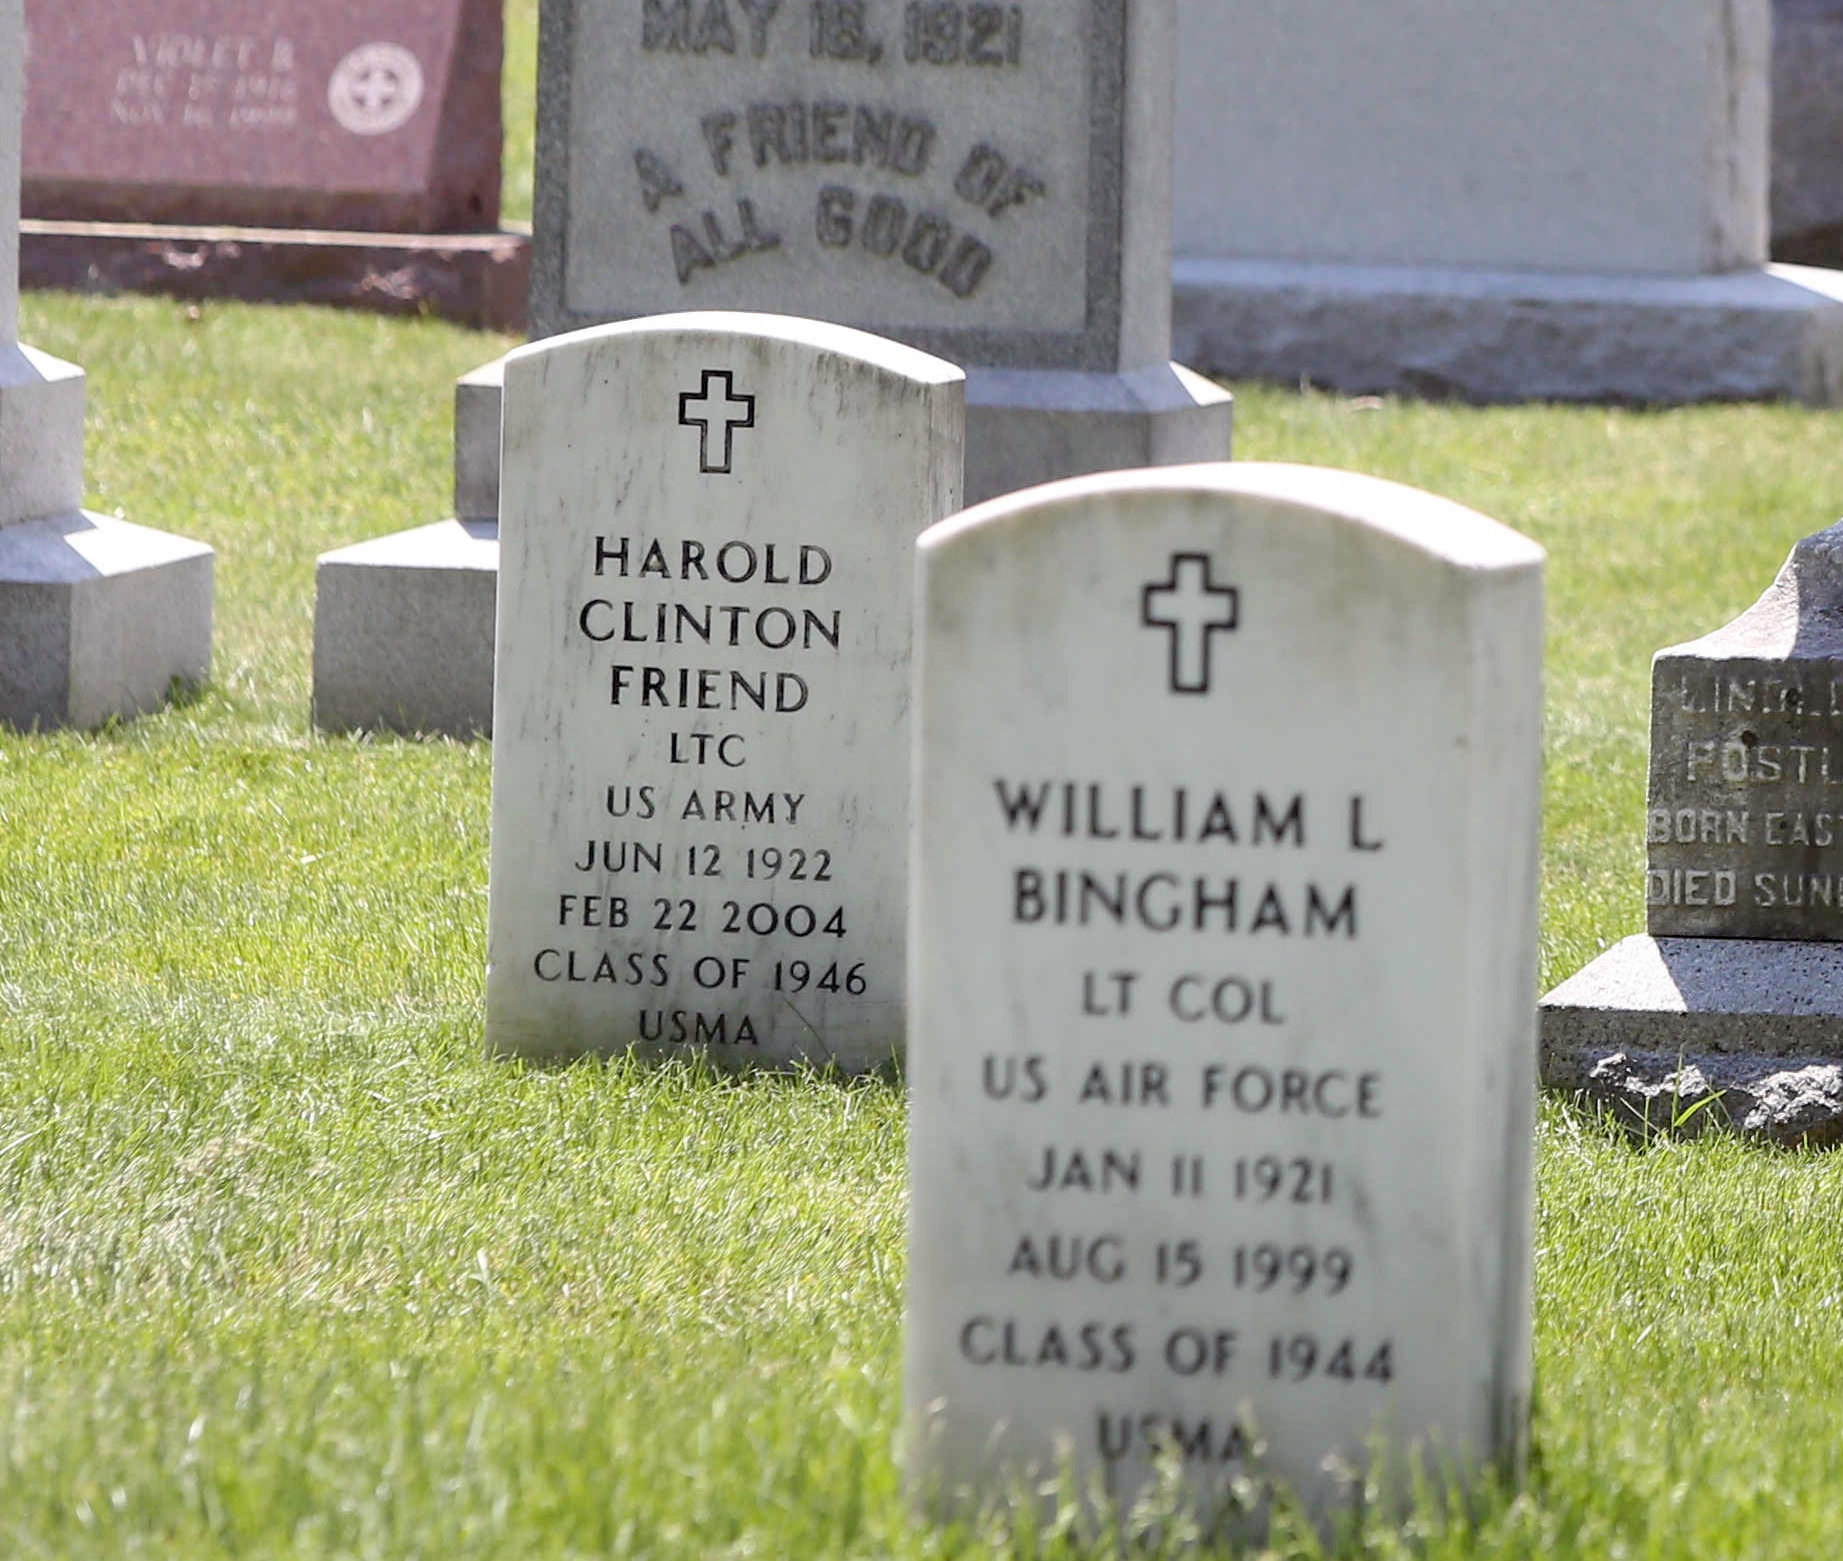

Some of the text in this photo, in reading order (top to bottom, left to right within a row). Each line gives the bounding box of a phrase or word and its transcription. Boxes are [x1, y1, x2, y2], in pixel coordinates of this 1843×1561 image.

[633, 100, 1047, 219] A FRIEND OF
[669, 184, 994, 301] ALL GOOD
[594, 535, 834, 586] HAROLD
[578, 599, 841, 650] CLINTON
[609, 665, 810, 713] FRIEND
[669, 732, 747, 768] LTC
[606, 785, 806, 825] US ARMY
[993, 779, 1386, 854] WILLIAM L
[1648, 807, 1750, 844] BORN
[574, 840, 833, 882] JUN 12 1922
[1647, 867, 1738, 906] DIED
[558, 894, 848, 939] FEB 22 2004
[1011, 867, 1360, 938] BINGHAM
[532, 948, 868, 997] CLASS OF 1946
[1081, 971, 1287, 1026] LT COL
[638, 1009, 761, 1046] USMA
[982, 1055, 1384, 1120] US AIR FORCE
[1027, 1147, 1335, 1206] JAN 11 1921
[1007, 1235, 1354, 1297] AUG 15 1999
[958, 1317, 1395, 1385] CLASS OF 1944
